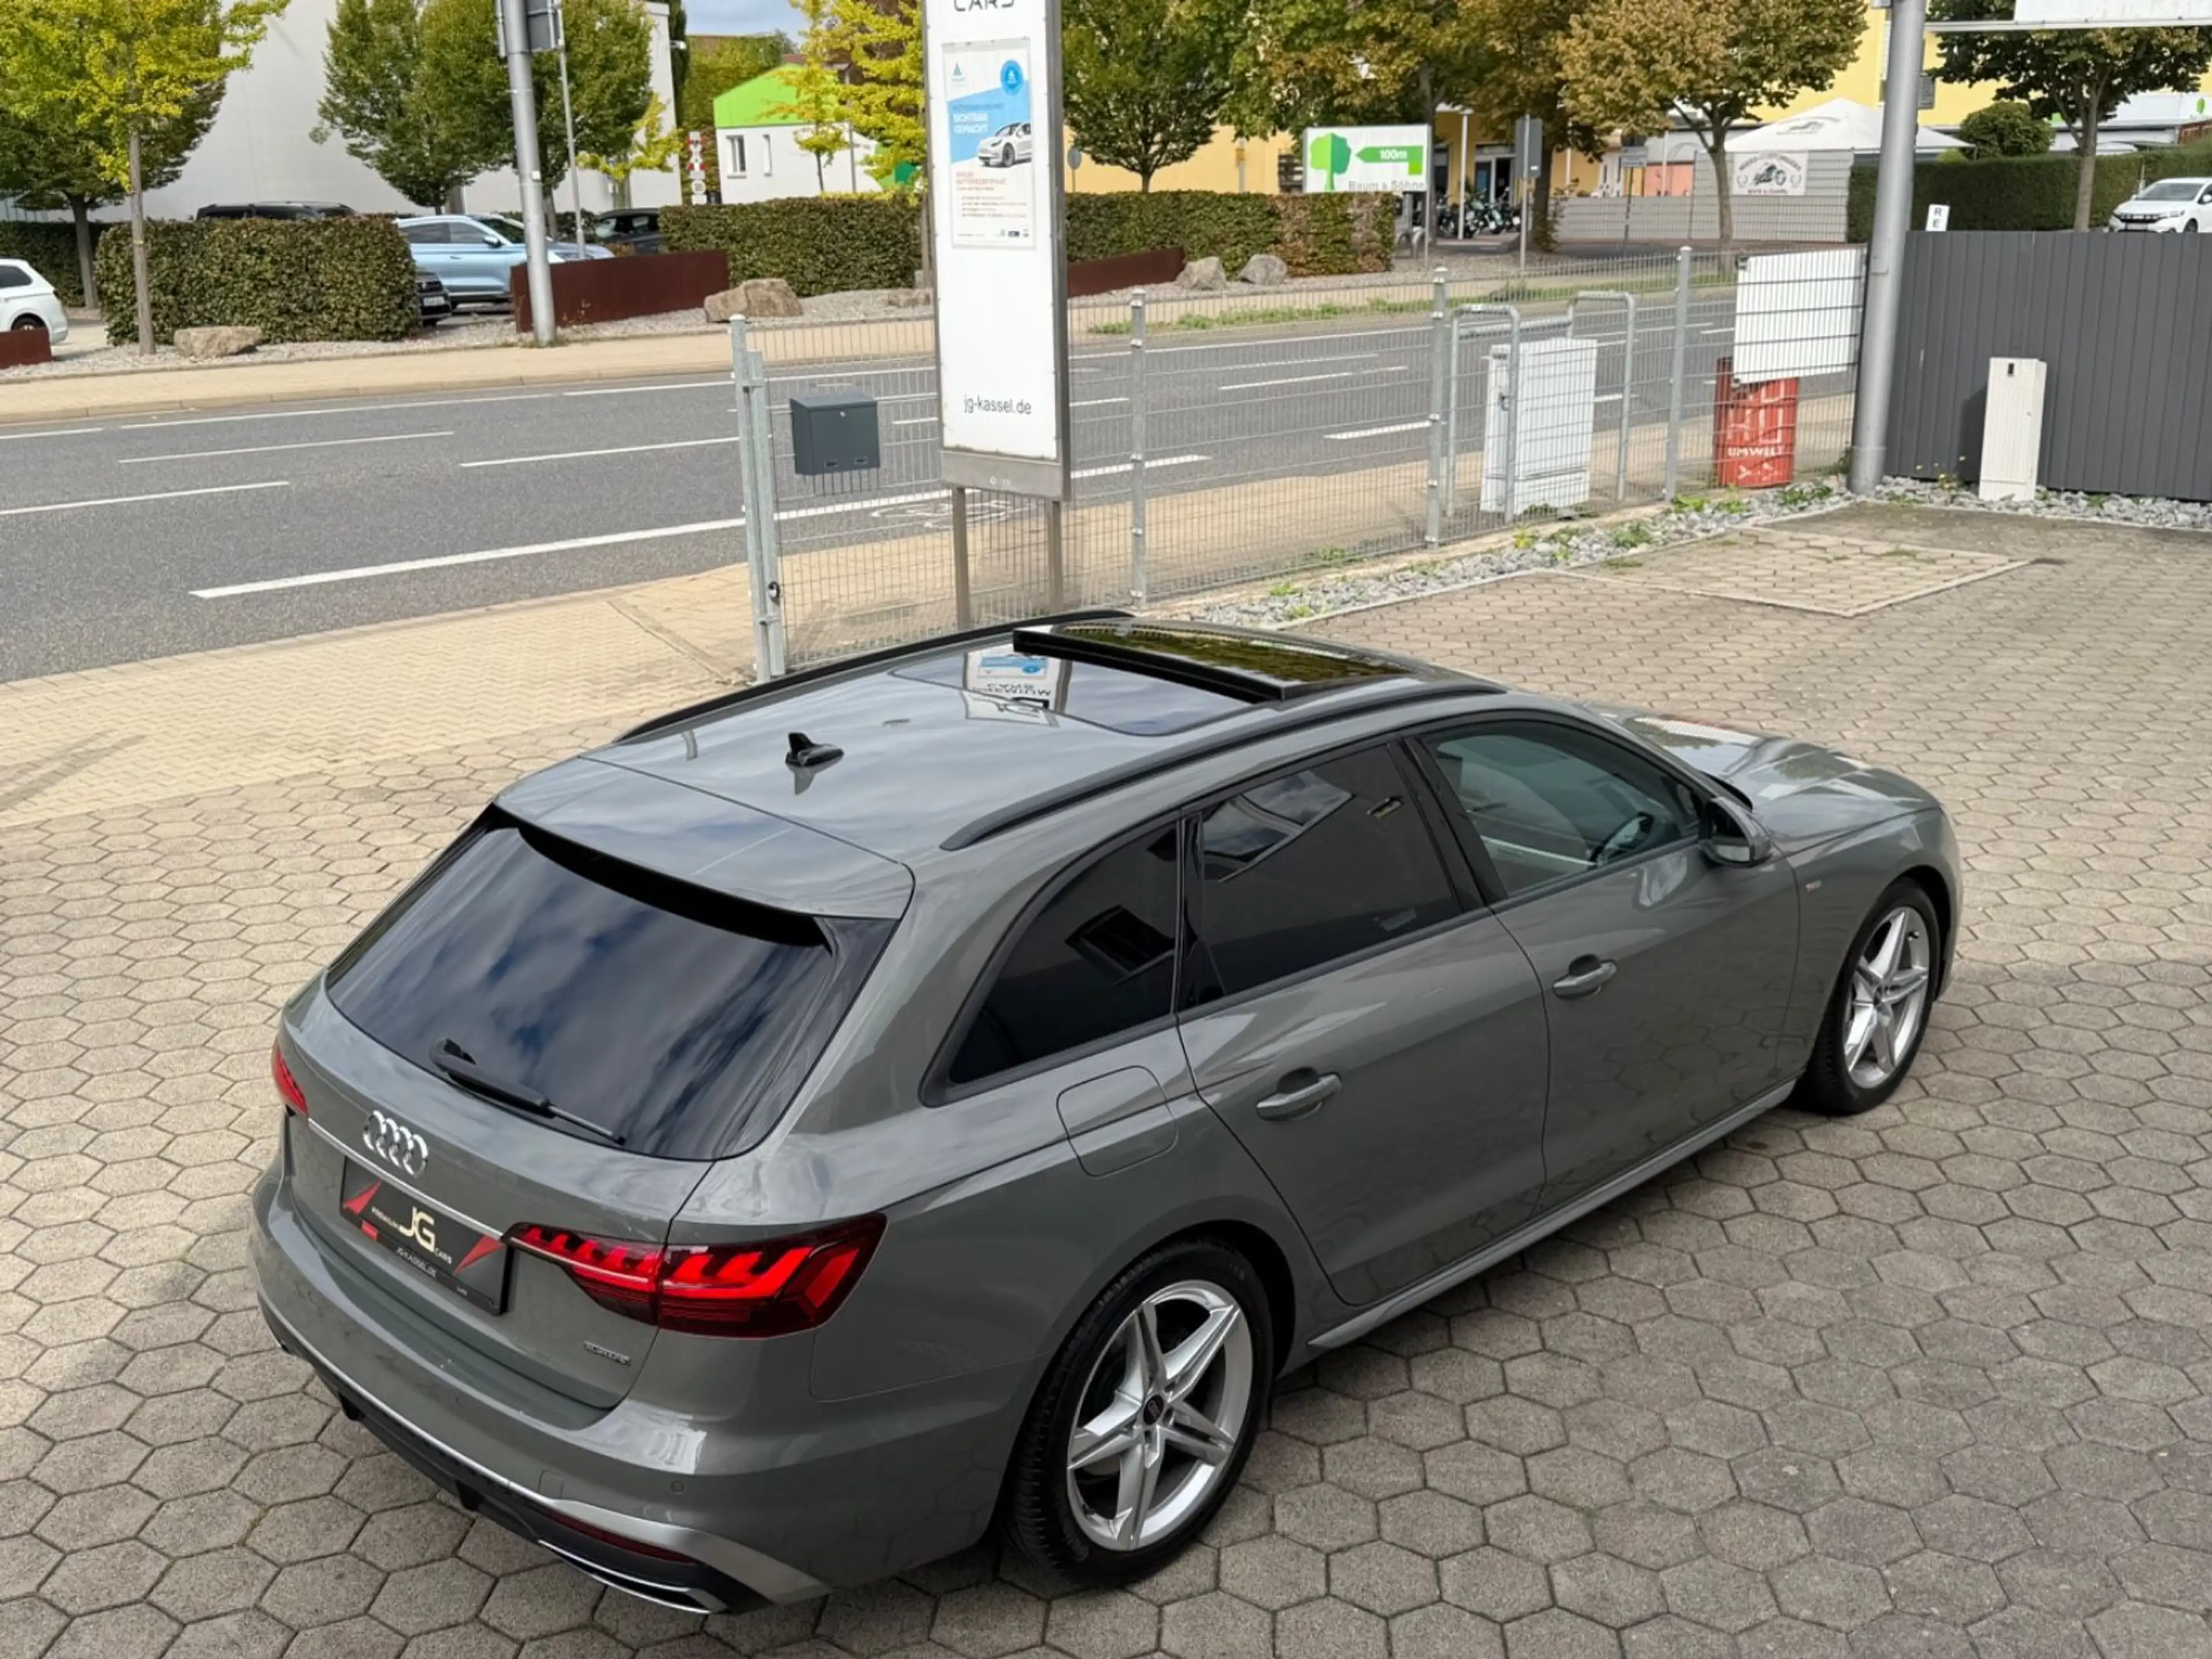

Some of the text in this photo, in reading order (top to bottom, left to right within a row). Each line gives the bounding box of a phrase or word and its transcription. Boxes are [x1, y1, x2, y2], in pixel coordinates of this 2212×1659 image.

[1379, 148, 1408, 160] 100m
[964, 395, 1032, 415] jg-kassel.de
[398, 1206, 435, 1253] JG
